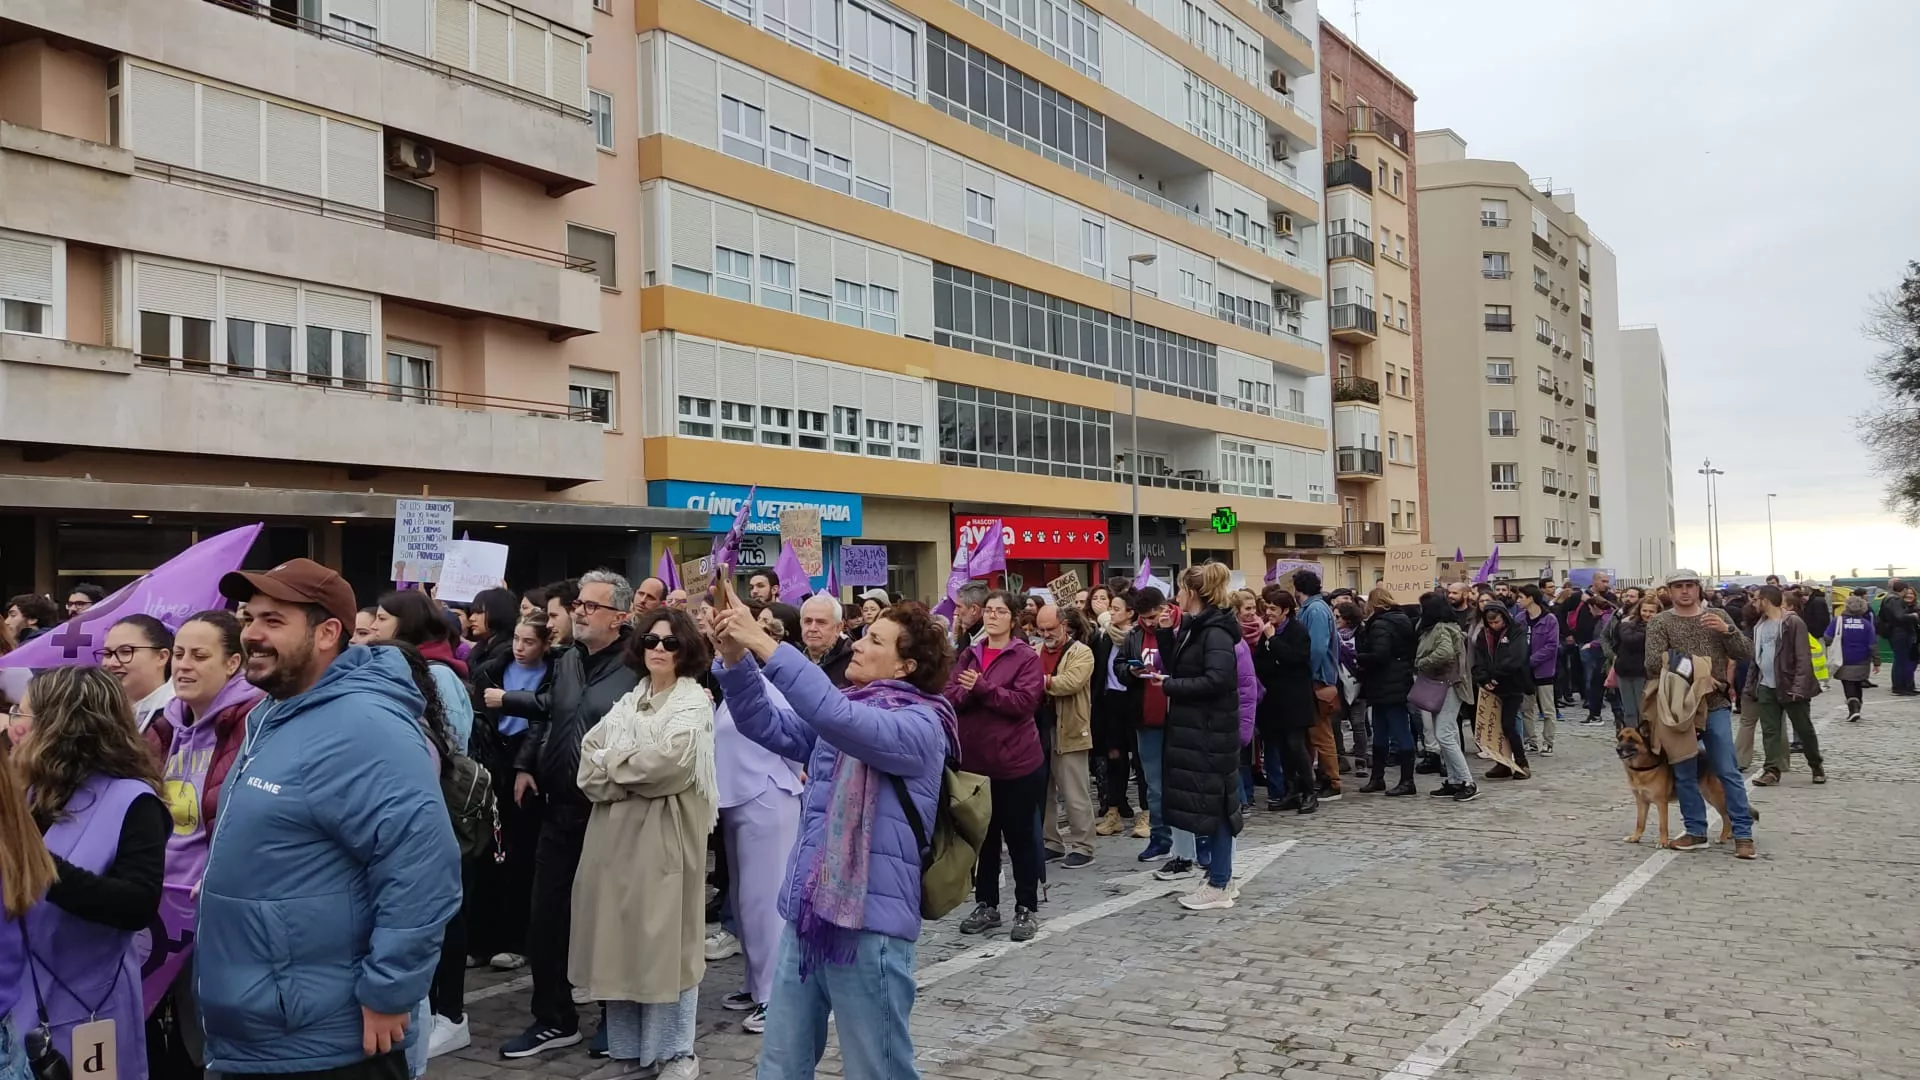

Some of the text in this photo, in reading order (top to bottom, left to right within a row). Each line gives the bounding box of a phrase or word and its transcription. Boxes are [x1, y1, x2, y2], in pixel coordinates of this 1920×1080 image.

[960, 521, 1015, 544] áva
[1126, 543, 1166, 557] FAMACIA
[1390, 549, 1436, 559] TODO EL
[247, 776, 281, 794] KELME
